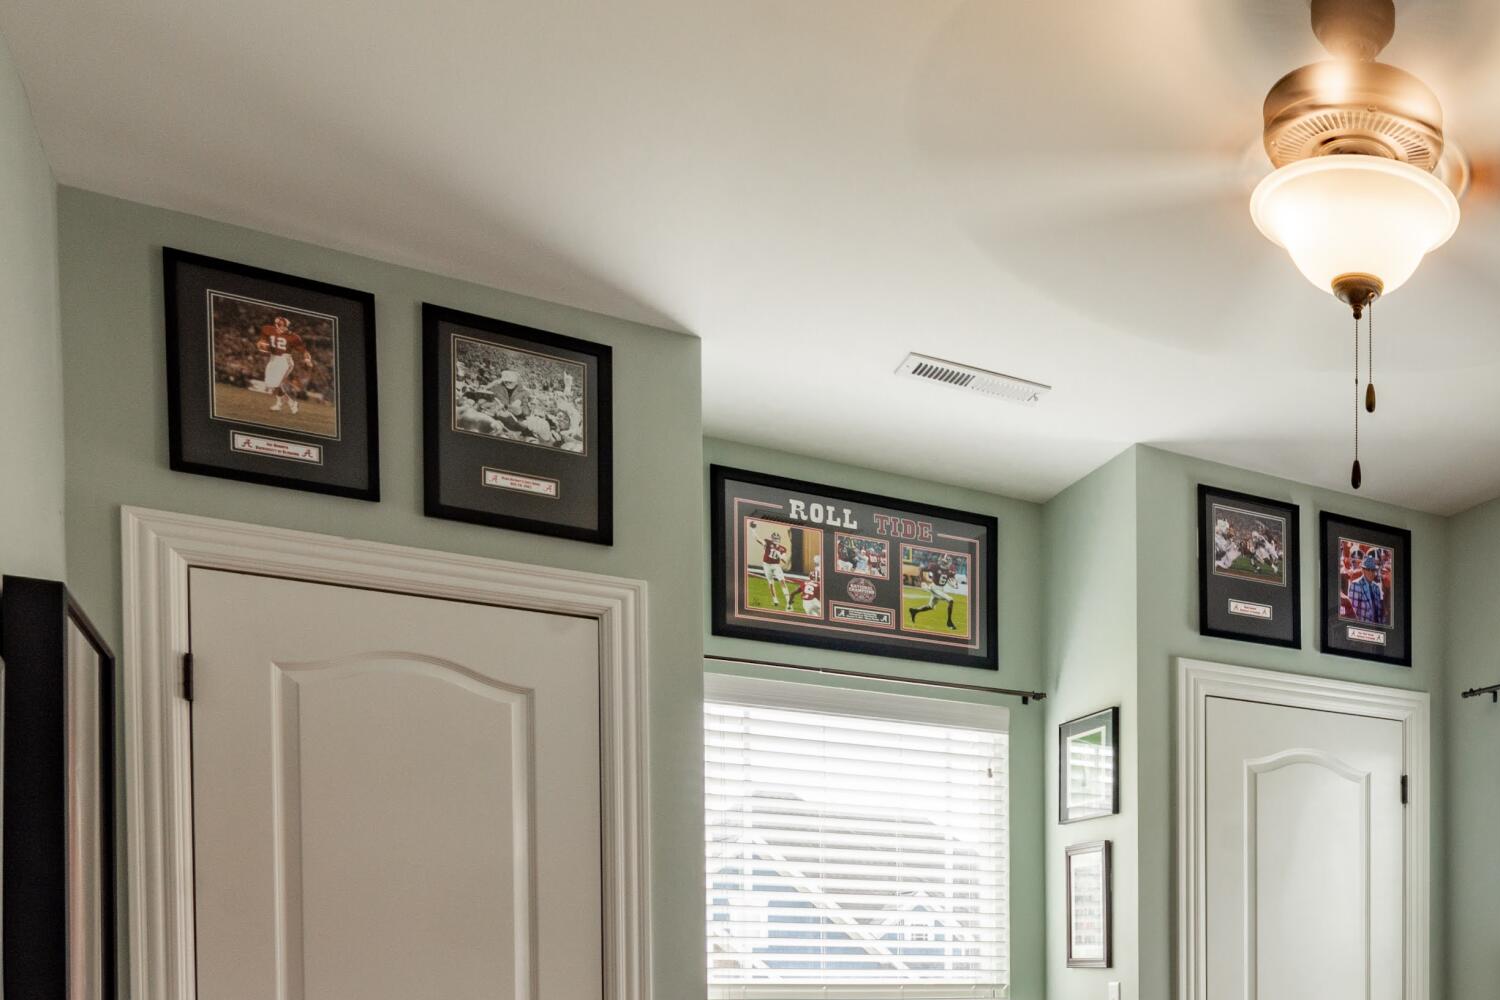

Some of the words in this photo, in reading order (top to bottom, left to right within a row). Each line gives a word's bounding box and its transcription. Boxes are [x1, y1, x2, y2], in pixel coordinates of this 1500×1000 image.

[270, 335, 287, 350] 12
[789, 499, 857, 530] ROLL
[874, 513, 933, 543] TIDE
